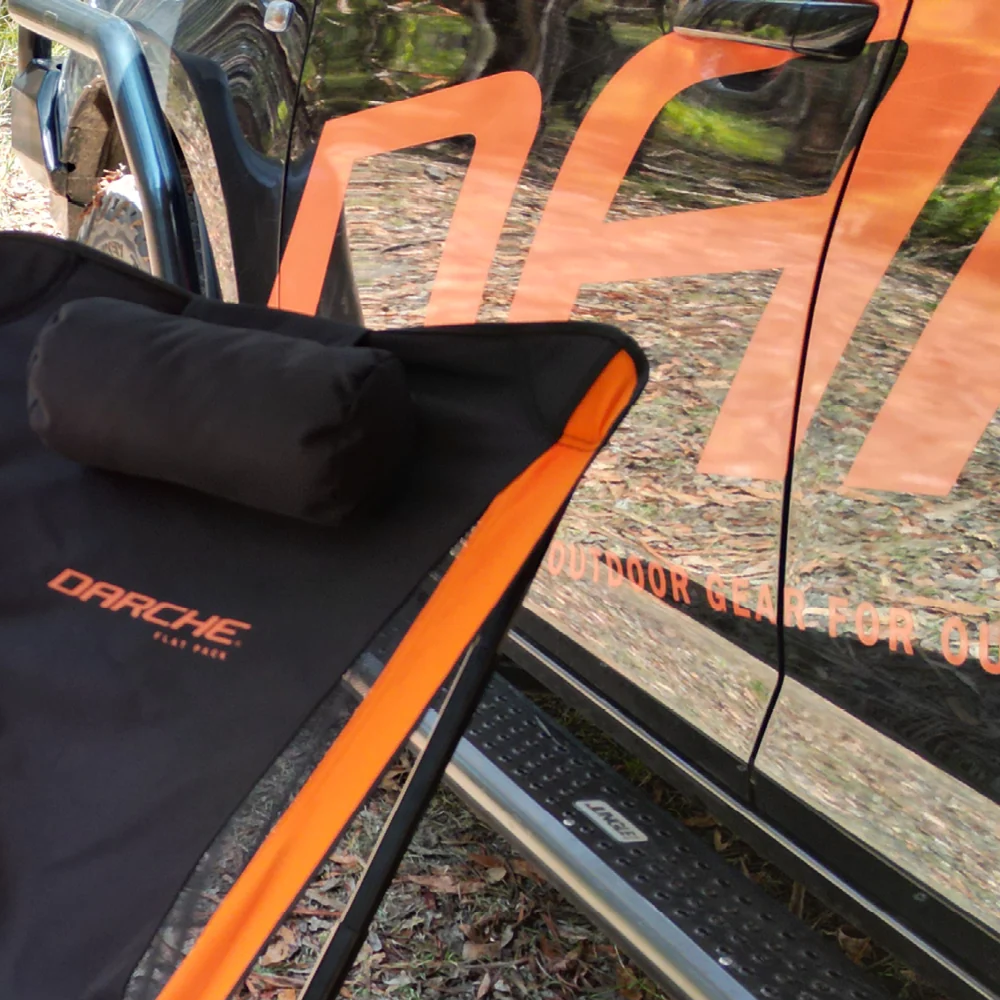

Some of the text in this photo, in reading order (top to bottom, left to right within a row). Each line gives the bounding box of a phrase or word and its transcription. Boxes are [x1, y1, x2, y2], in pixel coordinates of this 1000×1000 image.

[47, 568, 252, 645] DARCHE
[547, 538, 692, 605] OUTDOOR
[705, 572, 806, 631] GEAR
[827, 595, 914, 656] FOR
